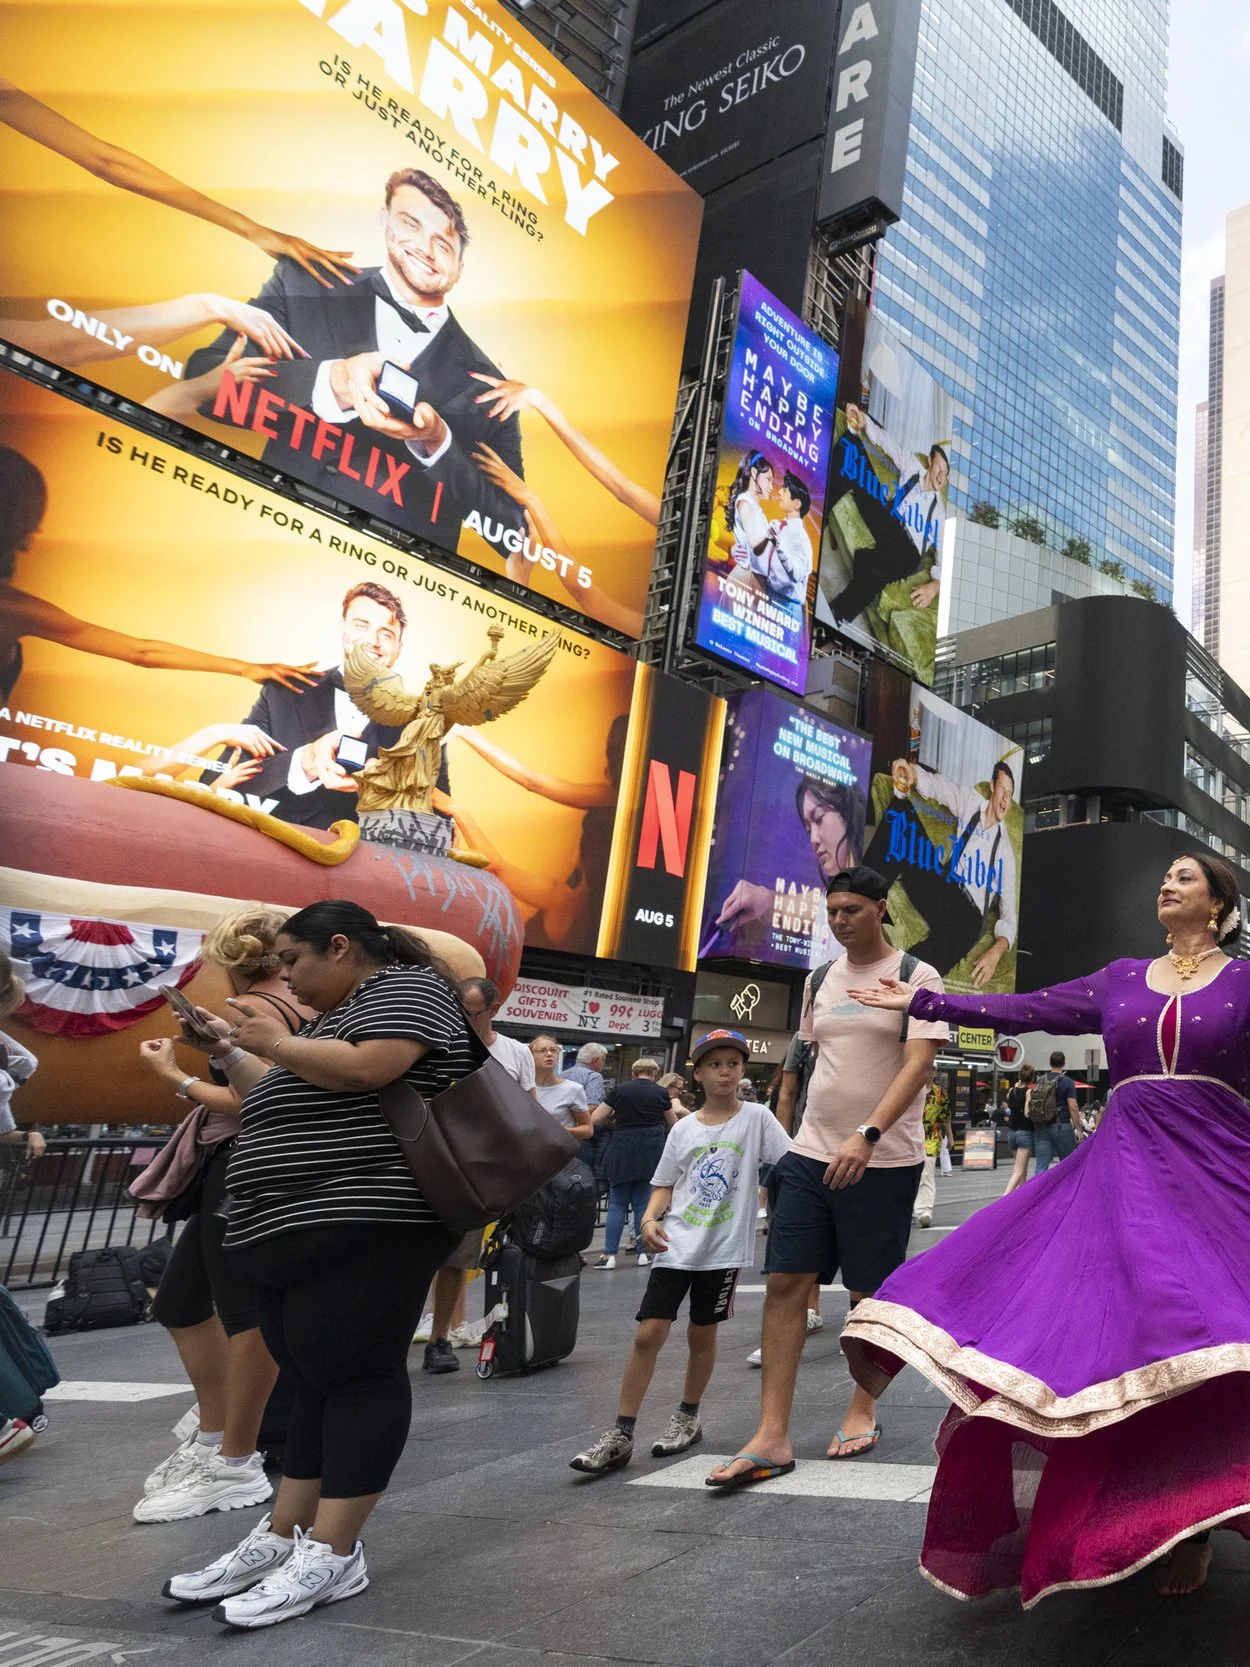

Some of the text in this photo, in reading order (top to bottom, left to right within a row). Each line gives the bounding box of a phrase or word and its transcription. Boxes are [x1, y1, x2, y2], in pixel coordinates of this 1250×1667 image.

[512, 38, 558, 88] SERIES
[663, 36, 780, 112] The Newest Classic
[719, 44, 806, 114] SEIKO
[302, 0, 615, 237] ARRY
[443, 5, 620, 182] MARRY
[319, 60, 545, 243] OR JUST ANOTHER FLING?
[333, 53, 538, 226] IS HE READY FOR A RING
[46, 299, 184, 380] ONLY ON
[755, 311, 826, 379] RIGHT OUTSIDE
[761, 301, 812, 351] ADVENTURE
[763, 332, 816, 383] YOUR DOOR
[743, 368, 822, 442] HAPPY
[745, 347, 823, 425] MAYBE
[212, 368, 411, 507] NETFLIX
[741, 389, 819, 463] ENDING
[748, 417, 810, 467] ON BROADWAY
[839, 436, 889, 506] Blue
[96, 431, 591, 660] IS HE READY FOR A RING OR JUST ANOTHER FING?
[462, 509, 593, 588] AUGUST 5
[717, 576, 801, 634] TONY AWARD
[732, 601, 785, 642] WINNER
[712, 608, 799, 665] BEST MUSICAL
[15, 711, 98, 742] NETFLIX
[98, 732, 176, 762] REALITY
[176, 750, 235, 774] SERIES
[773, 741, 791, 759] ON
[778, 727, 852, 771] NEW MUSICAL
[816, 728, 841, 750] BEST
[885, 808, 944, 875] Blue
[775, 877, 826, 903] MAYB
[635, 909, 674, 928] AUG 5
[775, 943, 792, 953] BEST
[506, 1006, 568, 1022] SOUVENIRS
[514, 983, 569, 998] DISCOUNT
[518, 996, 558, 1009] GIFTS &
[583, 990, 660, 1007] #1 Rated Souvenir Shop
[610, 1004, 633, 1018] 99¢
[577, 1014, 601, 1030] NY
[608, 1020, 631, 1031] Dept.
[643, 1020, 650, 1032] 3
[960, 1032, 993, 1046] CENTER
